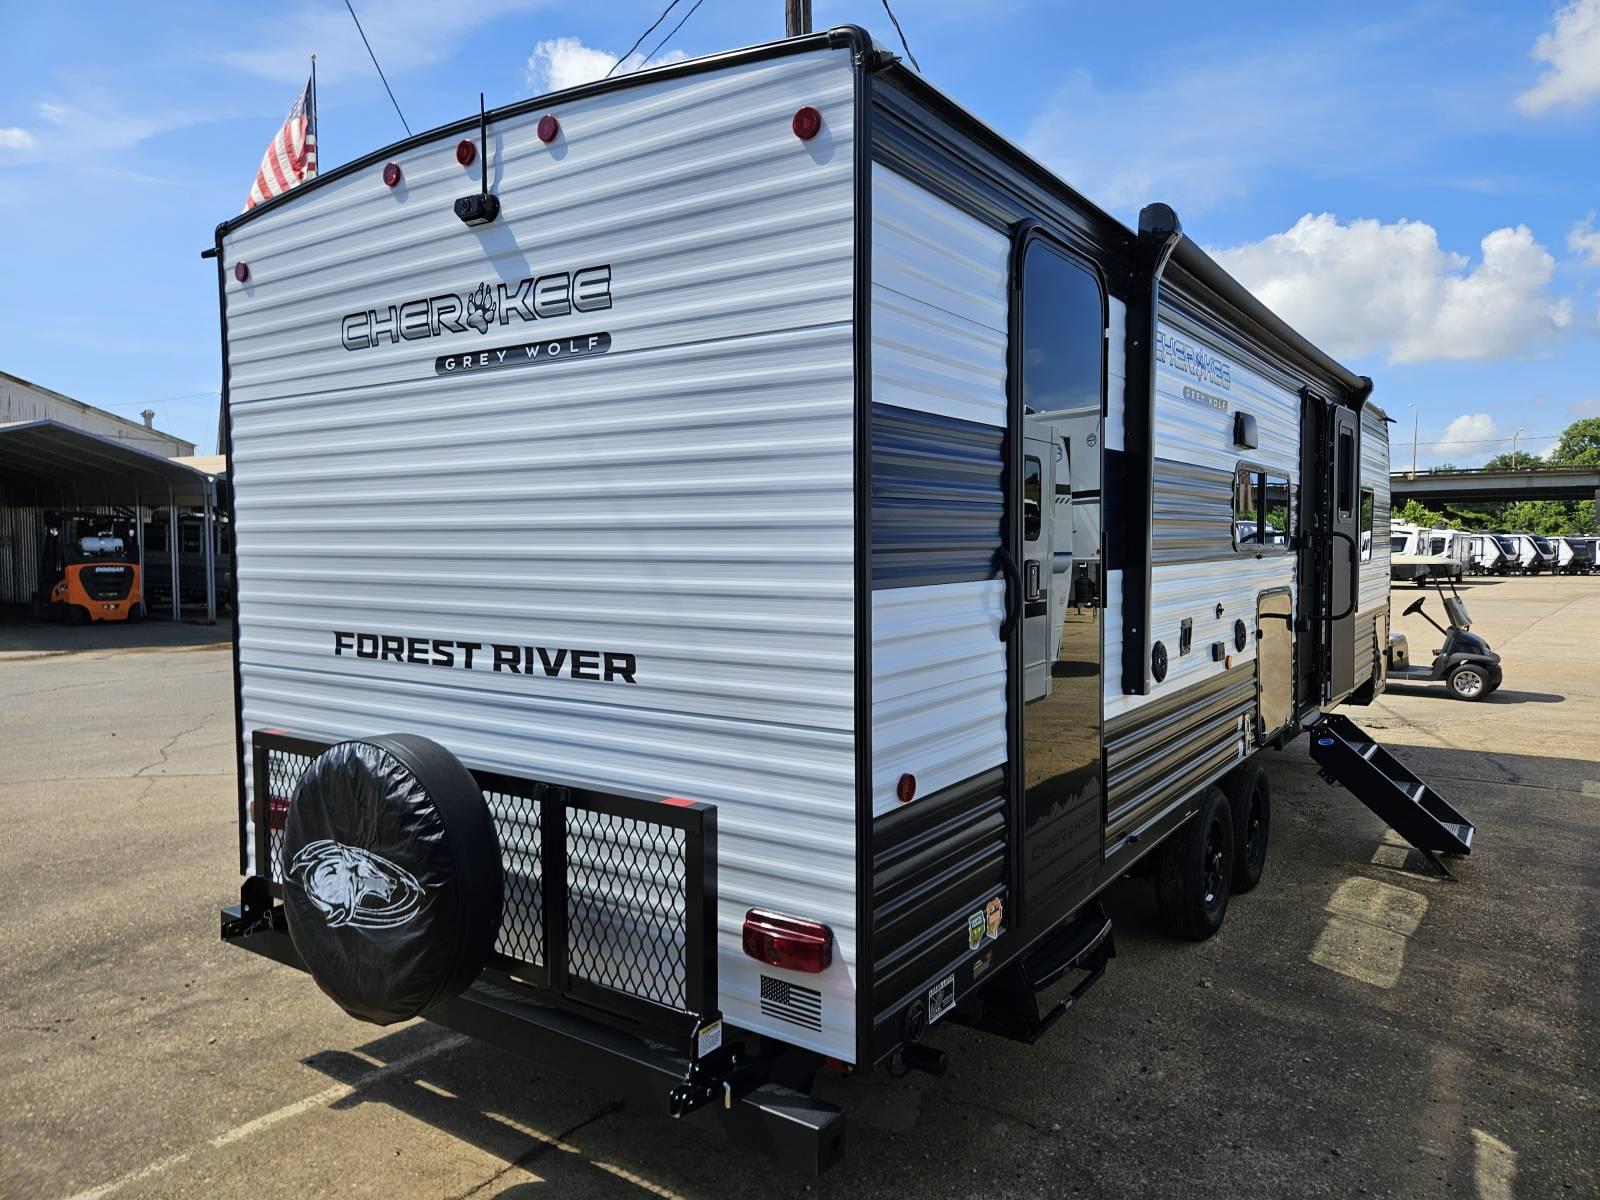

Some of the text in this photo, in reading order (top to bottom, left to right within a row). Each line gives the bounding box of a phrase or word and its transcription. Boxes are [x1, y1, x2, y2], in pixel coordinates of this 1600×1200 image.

[445, 336, 599, 371] GREY WOLF
[333, 631, 637, 684] FOREST RIVER
